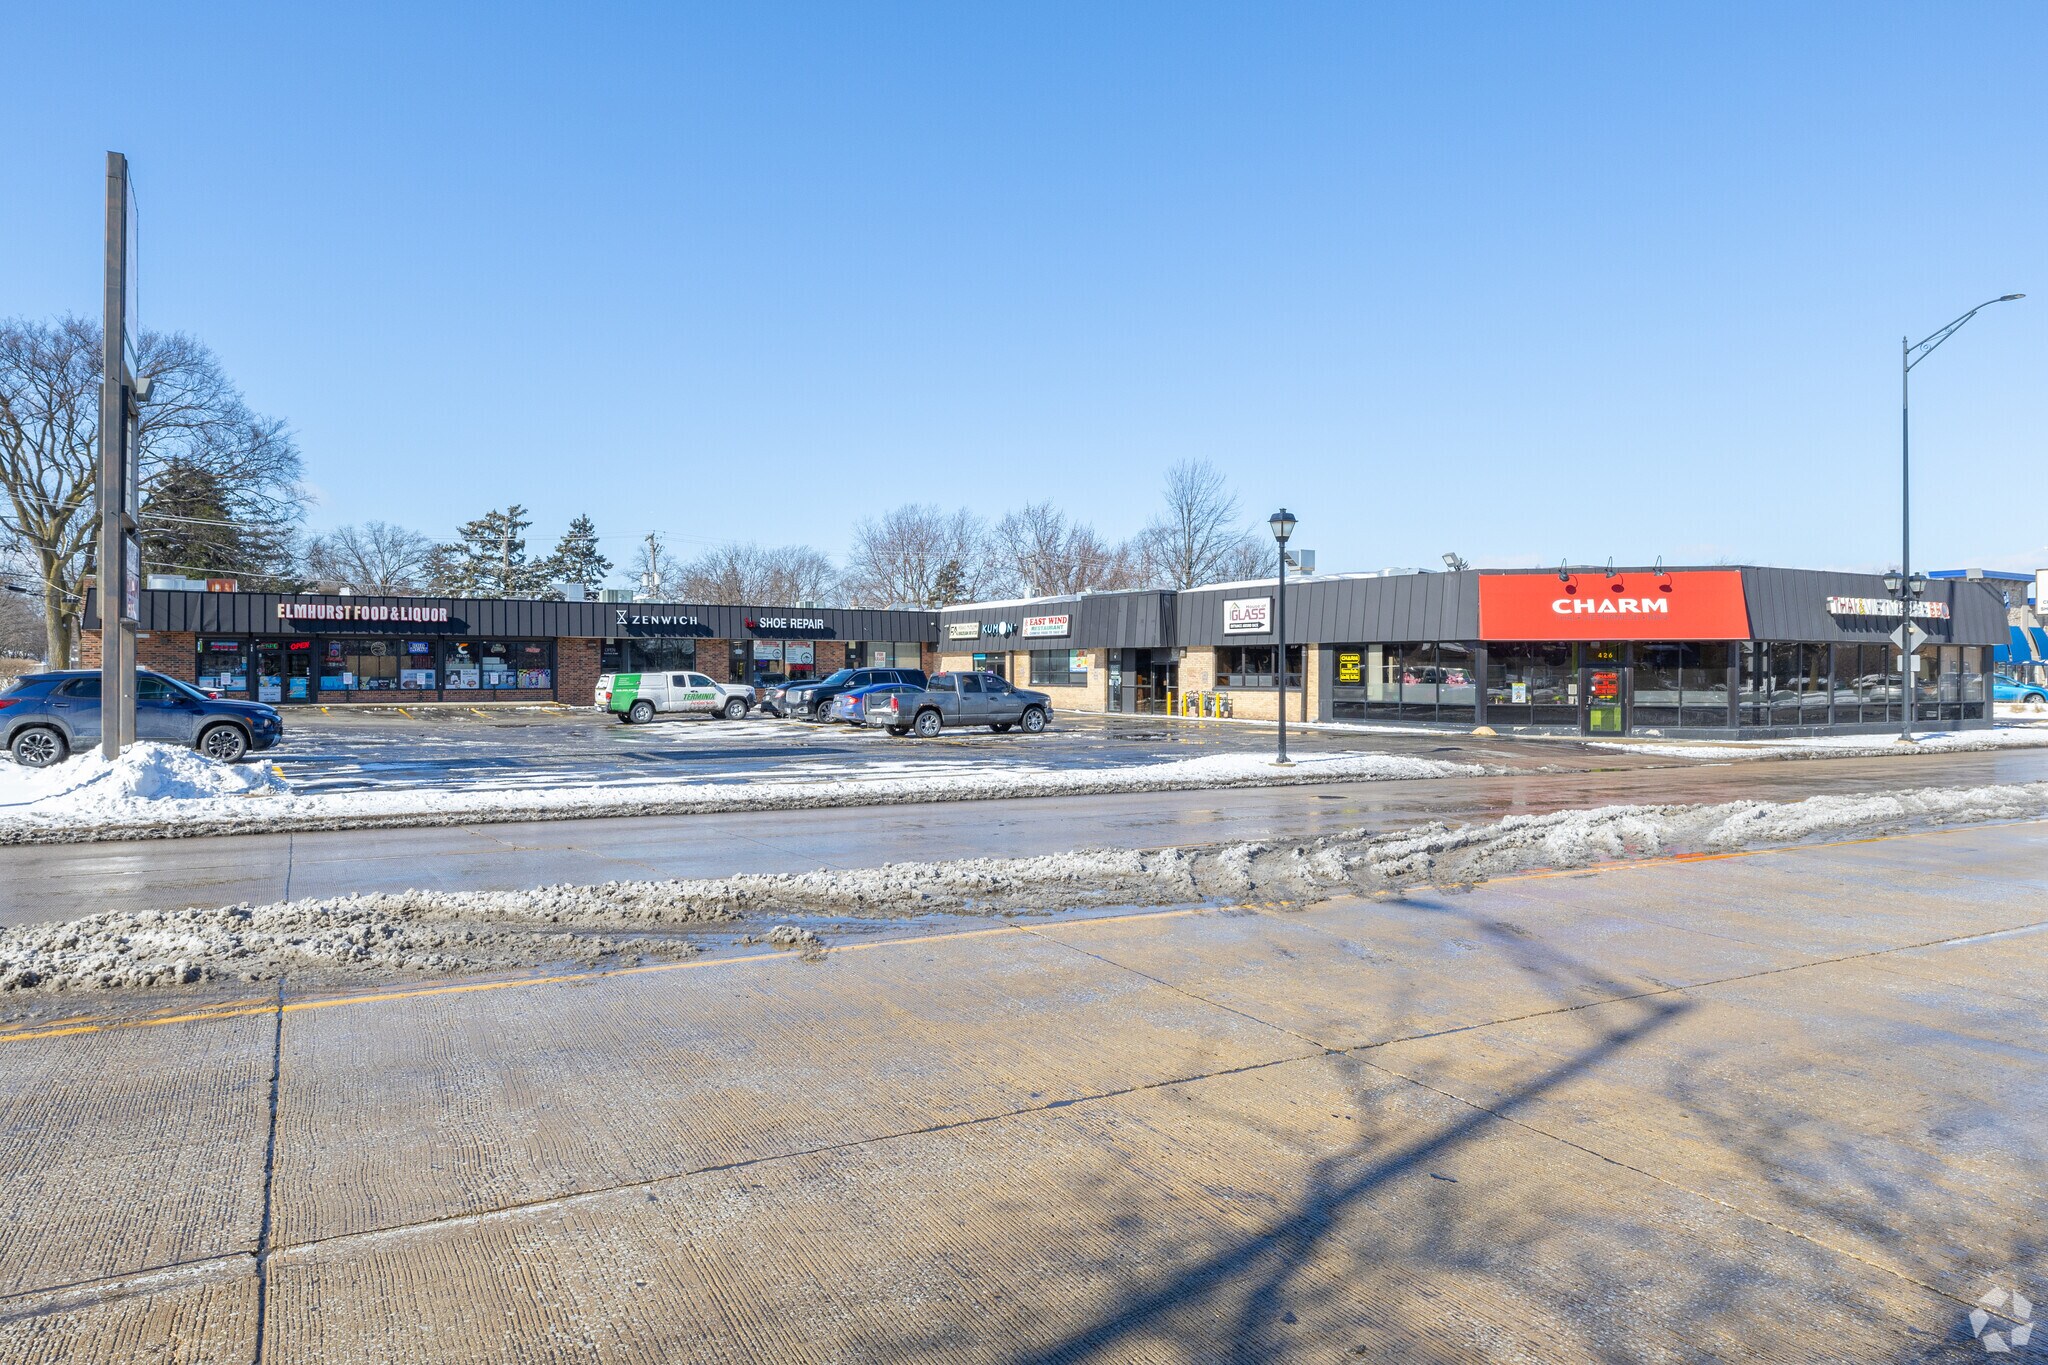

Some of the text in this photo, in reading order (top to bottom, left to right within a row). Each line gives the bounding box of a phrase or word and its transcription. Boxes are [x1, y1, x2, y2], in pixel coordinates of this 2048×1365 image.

[277, 603, 448, 622] ELMHURST FOOD & LIQUOR
[1552, 598, 1668, 614] CHARM
[631, 615, 698, 626] ZENWICH
[1029, 616, 1067, 626] EAST WIND
[1232, 608, 1265, 621] GLASS
[760, 617, 787, 629] SHOE
[790, 618, 824, 630] REPAIR
[982, 621, 1013, 635] KUMON
[290, 641, 310, 650] OPEN
[683, 692, 716, 701] TERMINIX
